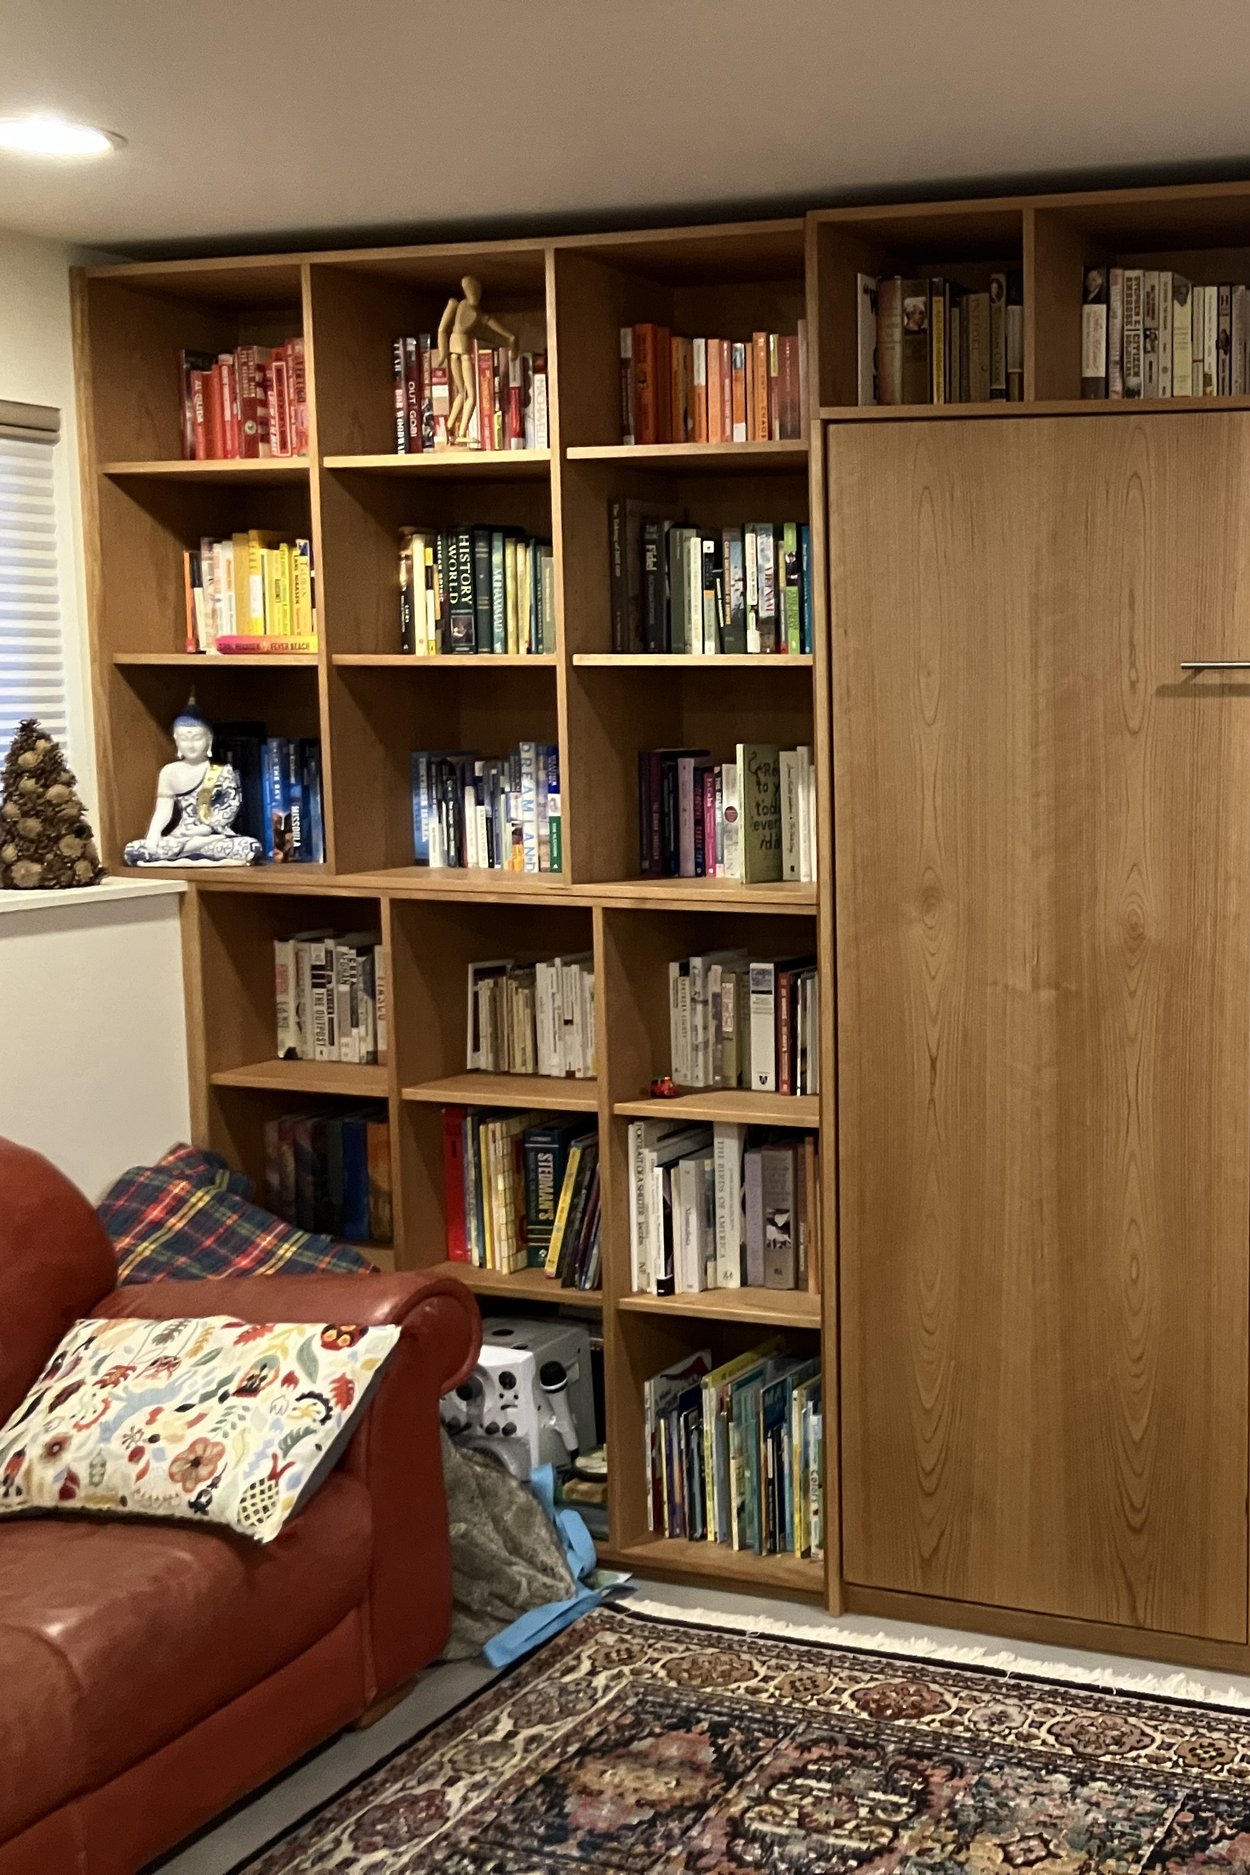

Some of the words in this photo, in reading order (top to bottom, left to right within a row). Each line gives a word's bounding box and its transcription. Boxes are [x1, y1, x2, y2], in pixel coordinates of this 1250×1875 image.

[408, 381, 416, 404] OUT
[409, 410, 417, 437] GOBI
[448, 545, 459, 604] WORLD
[459, 535, 472, 604] HISTORY
[646, 544, 657, 571] Fidel
[291, 806, 301, 847] MISSOULA
[520, 743, 536, 872] DREAMLAND
[314, 992, 325, 1006] THE
[315, 1010, 326, 1047] OUTPOST
[635, 1124, 644, 1164] PORTRAIT
[717, 1140, 725, 1161] THE
[537, 1153, 554, 1220] STEDMAN'S
[718, 1197, 726, 1209] OF
[718, 1215, 726, 1259] AMERICA
